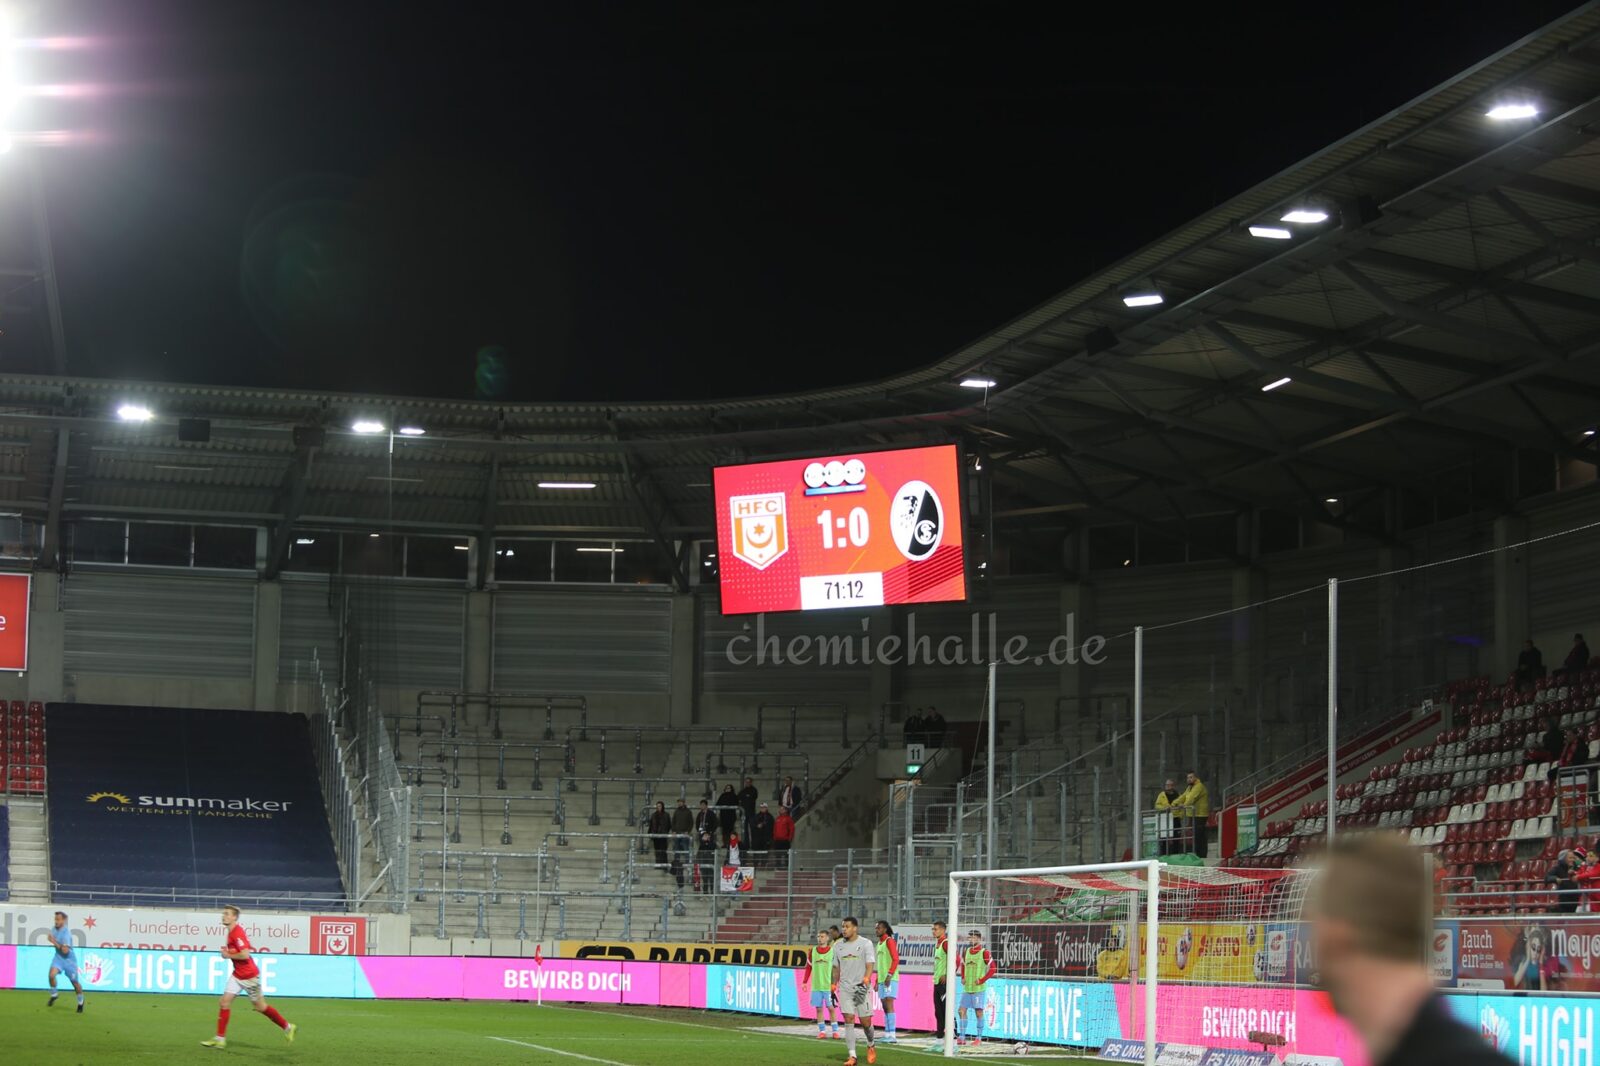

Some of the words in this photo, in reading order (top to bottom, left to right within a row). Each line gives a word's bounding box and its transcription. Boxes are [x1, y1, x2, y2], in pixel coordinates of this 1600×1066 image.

[737, 500, 779, 515] HFC
[816, 507, 870, 549] 1:0
[823, 580, 864, 600] 71:12
[910, 748, 920, 760] 11
[106, 806, 164, 815] WETTEN
[197, 810, 274, 819] FANSACHE
[138, 795, 293, 812] sunmaker
[128, 919, 200, 936] hunderte
[267, 924, 301, 939] tolle
[323, 924, 353, 935] HFC
[1461, 929, 1493, 949] Tauch
[1461, 949, 1479, 968] ein
[123, 953, 197, 990] HIGH
[503, 968, 584, 990] BEWIRB
[588, 971, 632, 992] DICH
[735, 969, 757, 1010] HIGH
[759, 971, 780, 1012] FIVE
[1003, 984, 1041, 1037] HIGH
[1045, 986, 1083, 1042] FIVE
[1202, 1006, 1258, 1039] BEWIRB
[1260, 1009, 1297, 1043] DICH
[1518, 1004, 1594, 1066] HIGH
[1103, 1043, 1122, 1057] PS
[1205, 1052, 1226, 1066] PS
